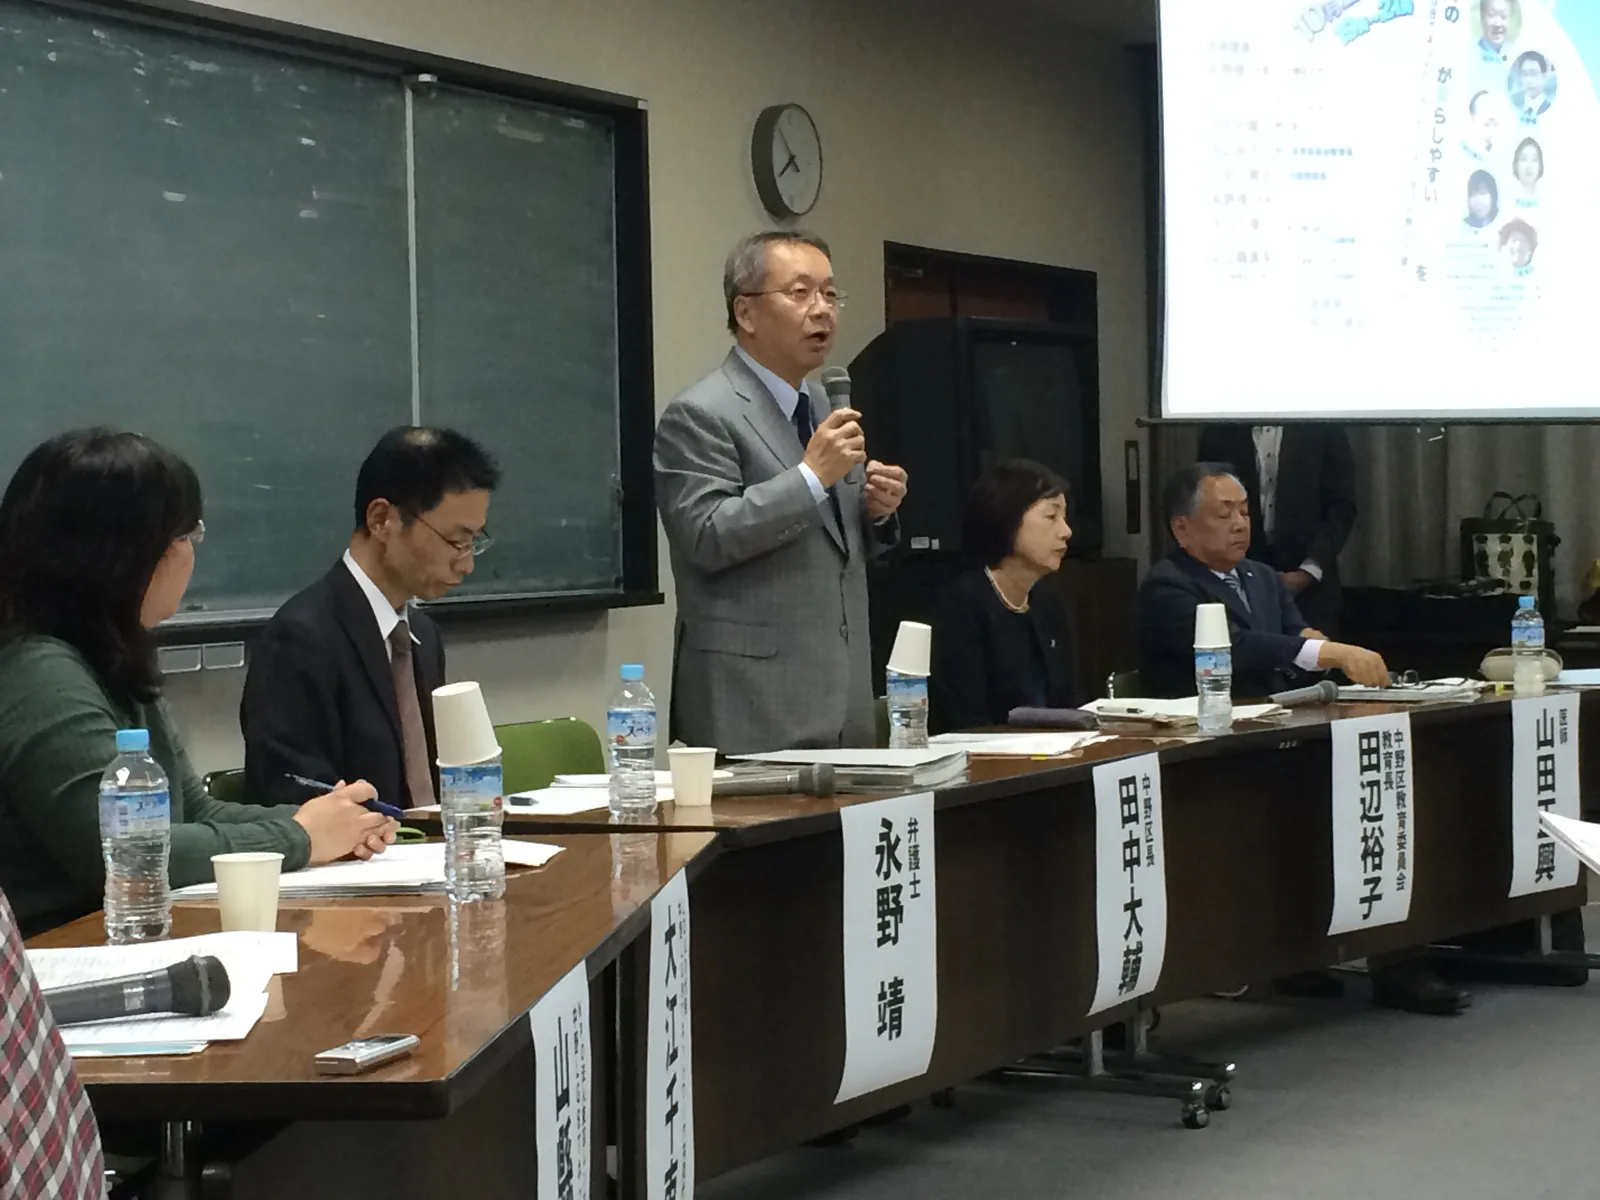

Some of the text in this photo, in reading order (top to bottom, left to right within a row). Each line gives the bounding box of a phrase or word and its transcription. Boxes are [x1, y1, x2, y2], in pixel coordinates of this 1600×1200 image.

[1358, 730, 1385, 920] 田辺裕子
[1382, 730, 1394, 791] 教育長
[906, 816, 922, 900] 弁護士
[1117, 774, 1144, 997] 田中大輔
